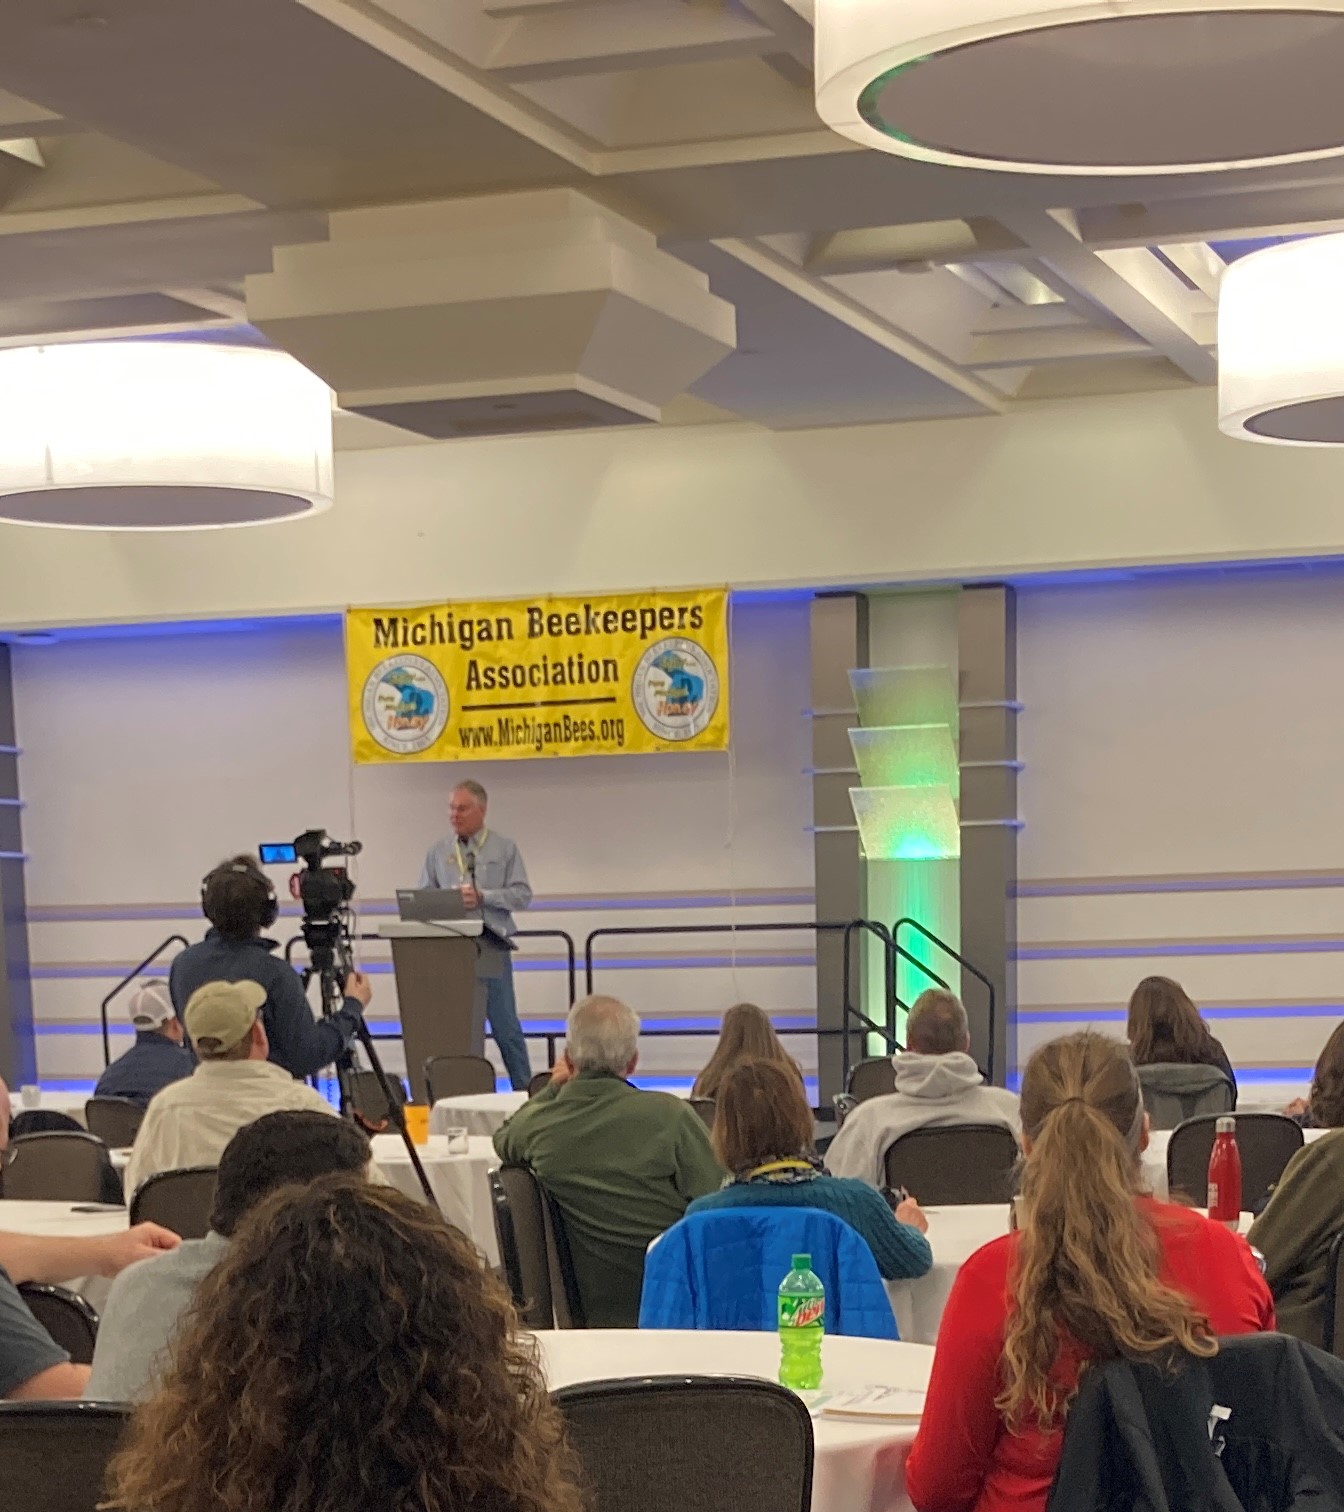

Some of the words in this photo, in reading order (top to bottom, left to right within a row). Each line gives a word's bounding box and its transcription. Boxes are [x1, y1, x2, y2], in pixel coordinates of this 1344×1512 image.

[373, 611, 514, 651] Michigan
[527, 604, 704, 640] Beekeepers
[466, 653, 619, 691] Association
[459, 715, 625, 752] www.MichiganBees.org
